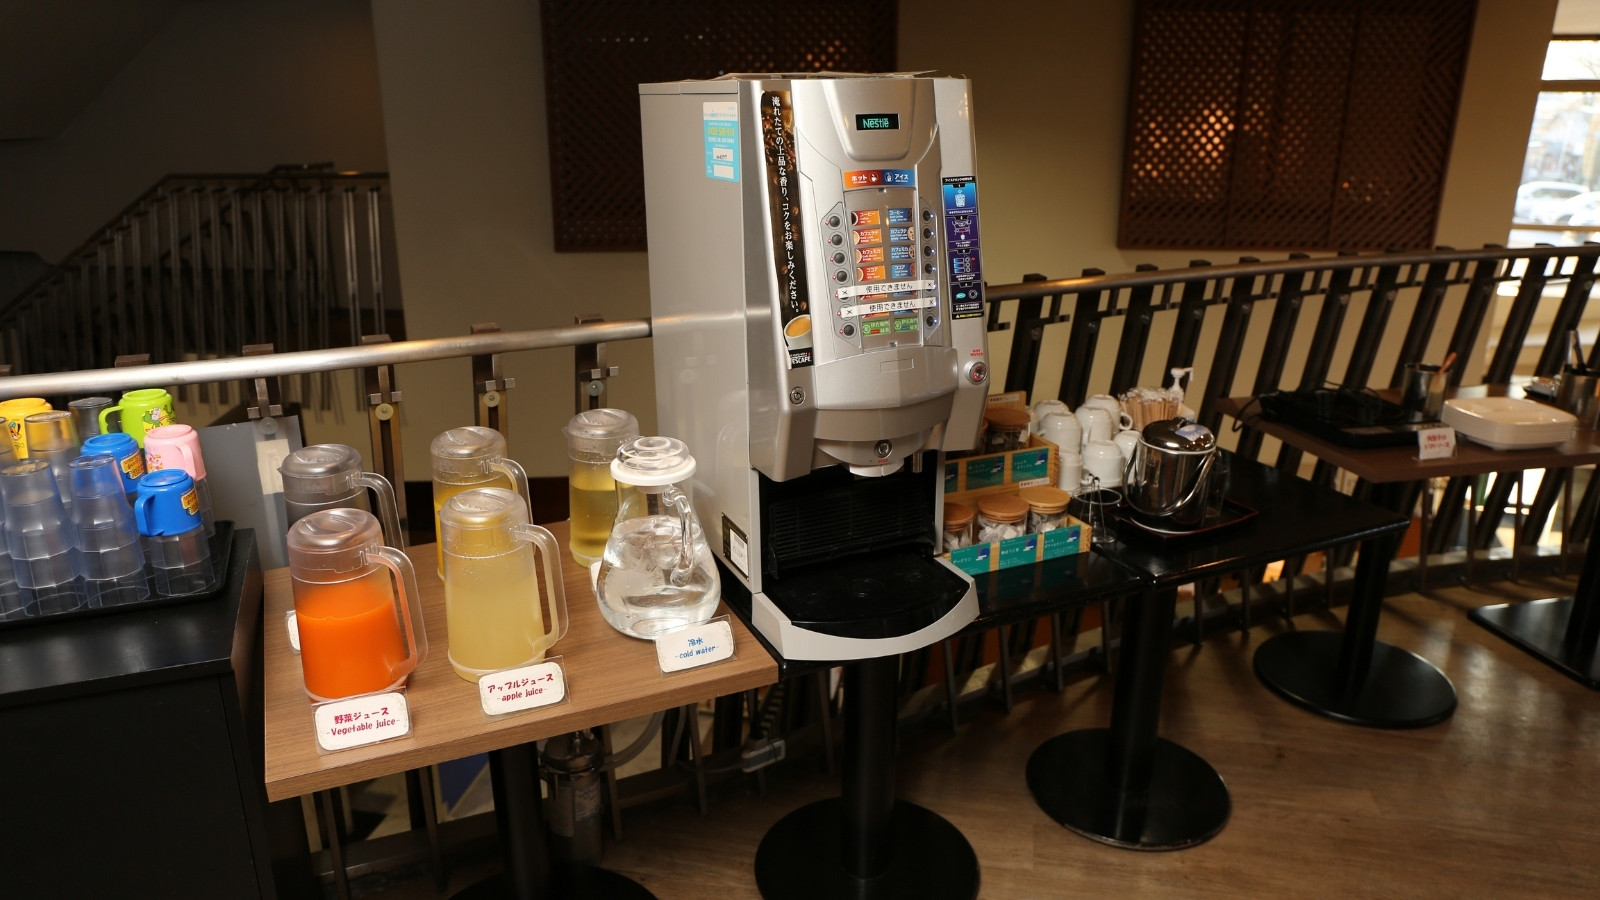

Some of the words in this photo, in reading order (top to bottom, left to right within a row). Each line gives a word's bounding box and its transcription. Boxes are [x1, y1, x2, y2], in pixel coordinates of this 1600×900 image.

[851, 174, 868, 182] ホット
[894, 173, 909, 181] アイス
[865, 283, 913, 294] 使用できません
[869, 301, 916, 312] 使用できません
[687, 637, 704, 647] 冷水
[487, 673, 554, 694] アップルジュース
[334, 706, 390, 725] 野菜ジュース
